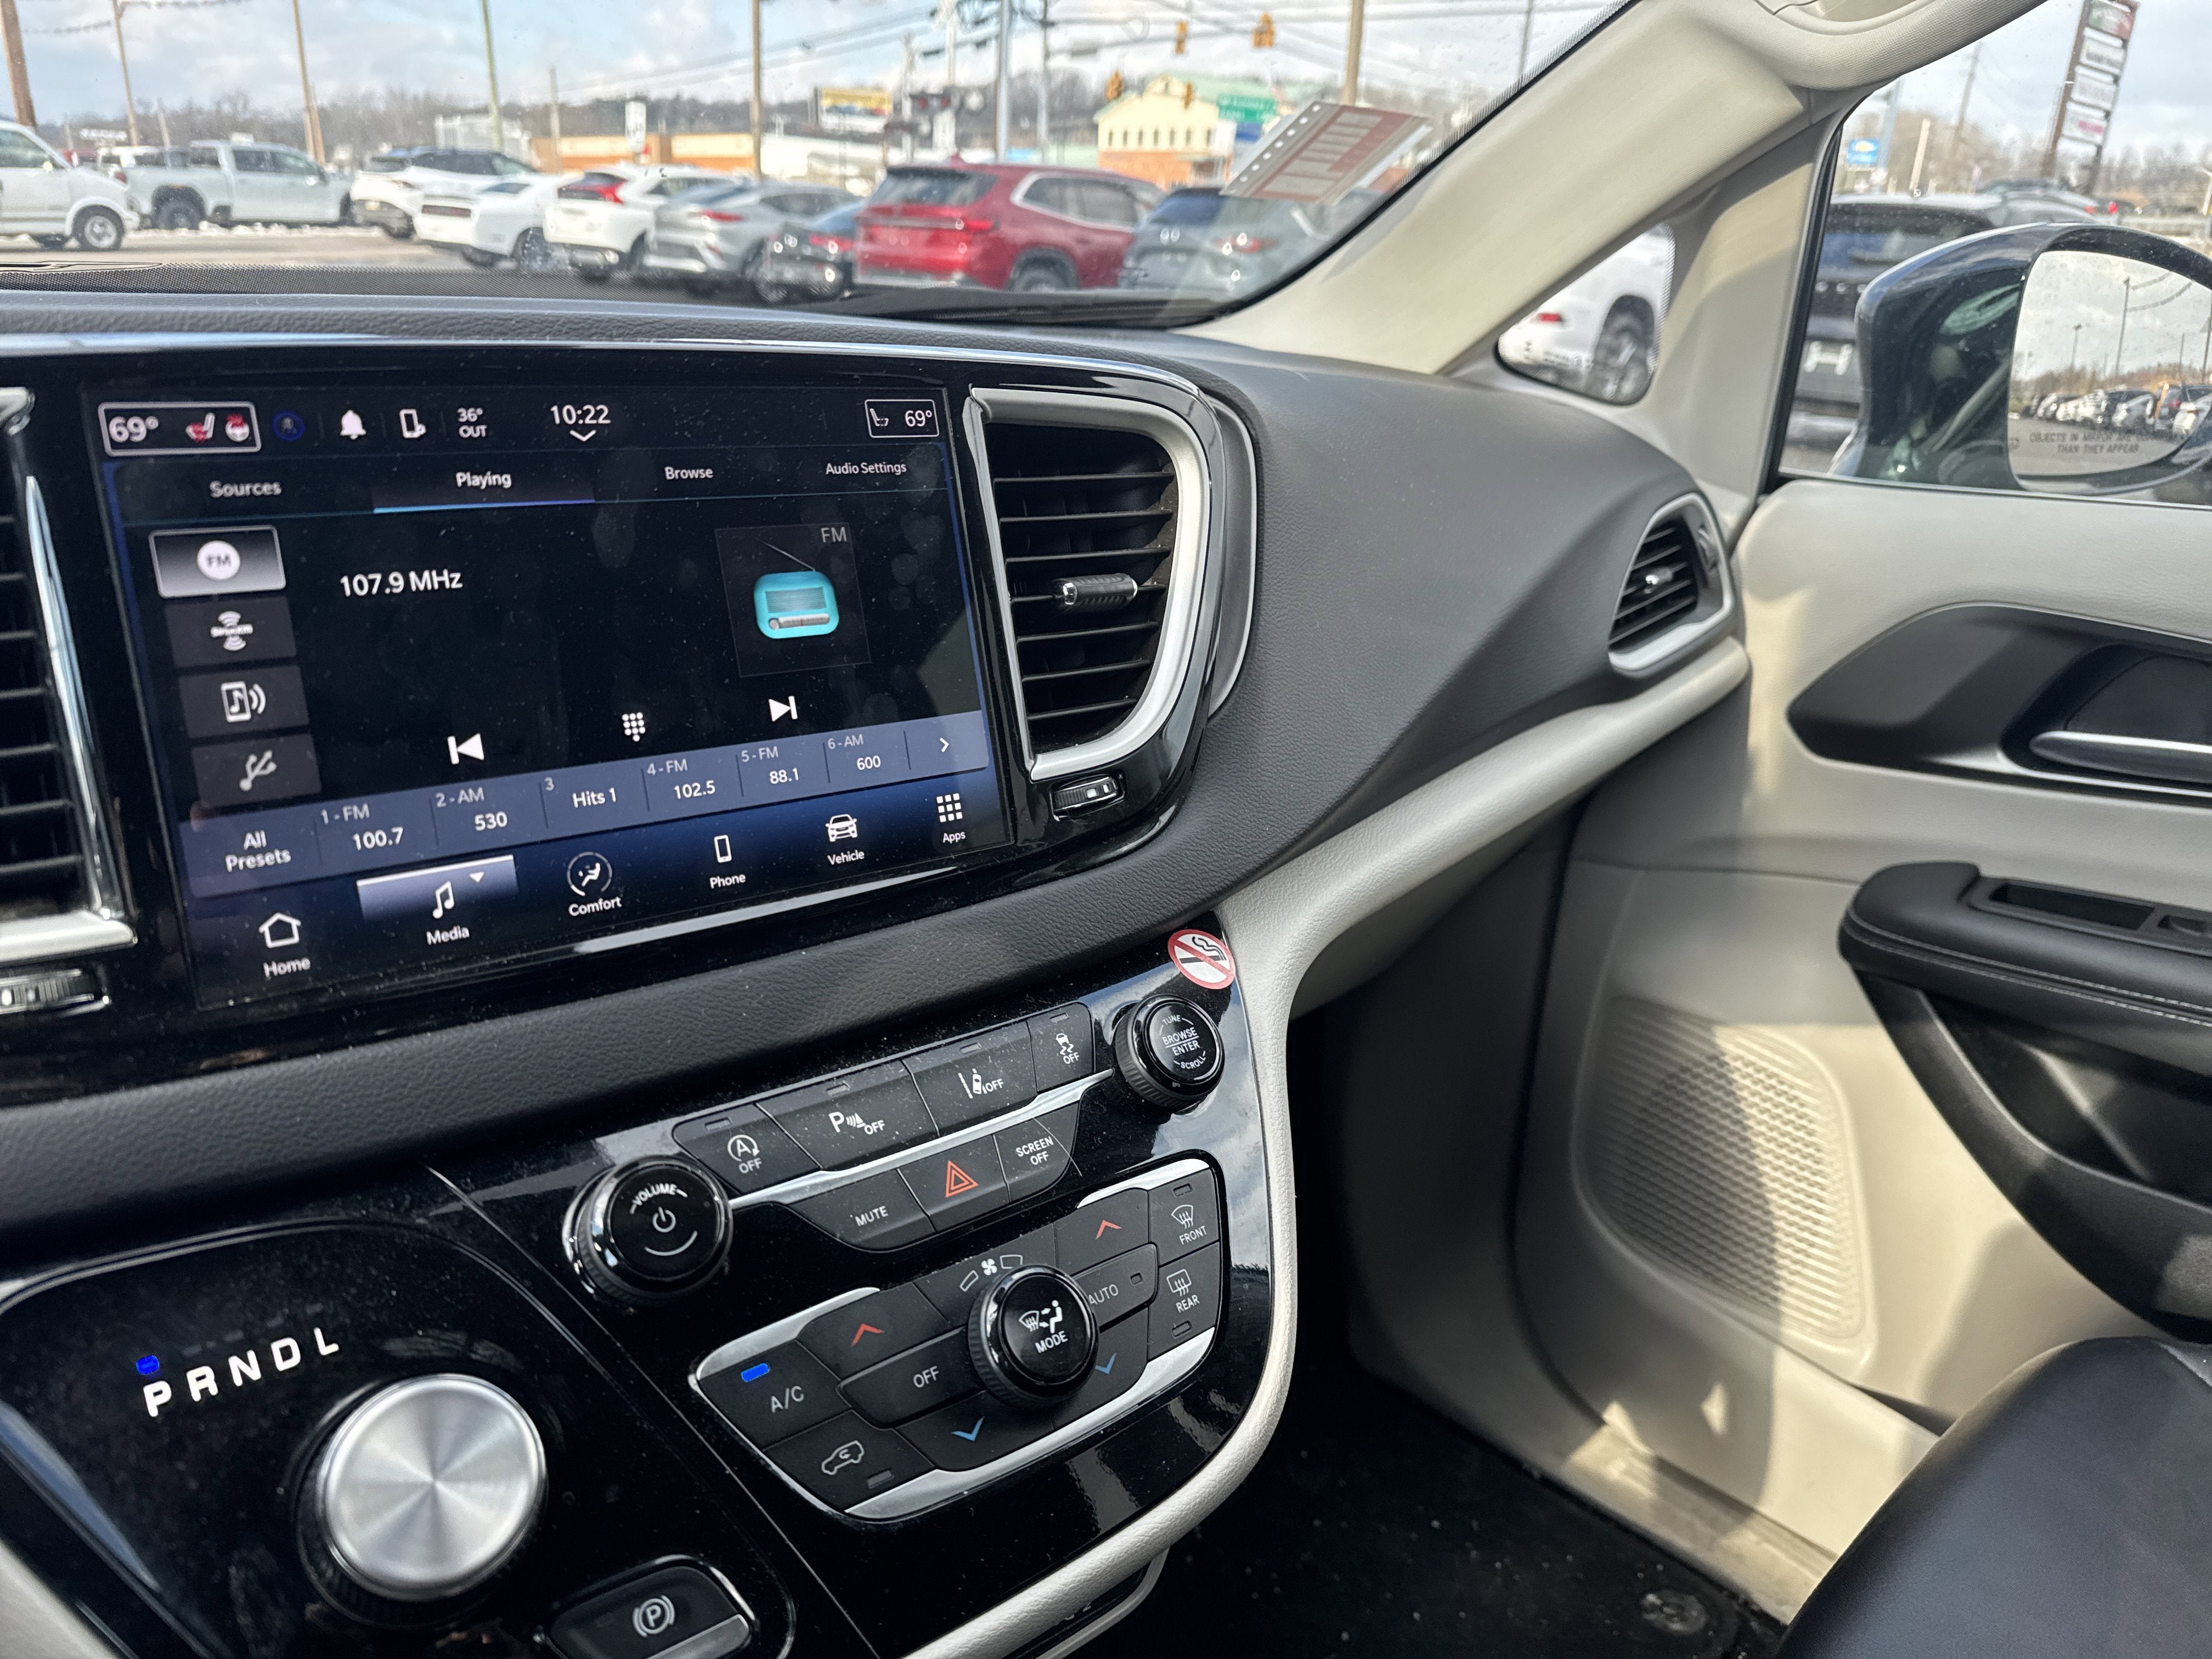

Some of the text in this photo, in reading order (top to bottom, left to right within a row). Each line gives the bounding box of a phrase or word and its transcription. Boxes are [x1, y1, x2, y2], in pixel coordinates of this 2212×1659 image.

[550, 403, 611, 426] 10:22
[459, 425, 488, 439] OUT
[2029, 432, 2067, 443] OBJECTS
[2057, 443, 2140, 454] THAN THEY APPEAR
[664, 465, 714, 481] Browse
[826, 460, 907, 476] Audio Settings
[210, 479, 282, 498] Sources
[456, 471, 512, 489] Playing
[821, 527, 848, 544] FM
[207, 554, 232, 568] FM
[340, 569, 464, 597] 107.9 MHz
[856, 755, 881, 771] 600
[544, 776, 555, 792] 3
[769, 768, 800, 785] 88.1
[572, 789, 607, 809] Hits
[673, 780, 716, 800] 102.5
[475, 811, 508, 832] 530
[244, 830, 267, 849] All
[352, 827, 404, 851] 100.7
[943, 830, 966, 845] Apps
[225, 848, 291, 872] Presets
[827, 849, 865, 865] Vehicle
[709, 872, 746, 889] Phone
[568, 896, 622, 917] Comfort
[426, 925, 470, 945] Media
[263, 956, 311, 978] Home
[1162, 1015, 1181, 1025] TUNE
[1161, 1027, 1198, 1045] BROWSE
[1172, 1040, 1200, 1056] ENTER
[1063, 1052, 1080, 1064] OFF
[1180, 1055, 1206, 1069] SCROLL
[985, 1078, 1003, 1092] OFF
[828, 1111, 885, 1135] P OFF
[1015, 1137, 1054, 1158] SCREEN
[738, 1158, 762, 1174] OFF
[1030, 1151, 1048, 1166] OFF
[633, 1183, 676, 1206] VOLUME
[855, 1205, 889, 1227] MUTE
[1179, 1225, 1207, 1245] FRONT
[1088, 1284, 1119, 1305] AUTO
[1176, 1294, 1200, 1313] REAR
[1035, 1331, 1069, 1354] MODE
[913, 1366, 940, 1388] OFF
[770, 1386, 804, 1413] A/C
[646, 1605, 661, 1627] P
